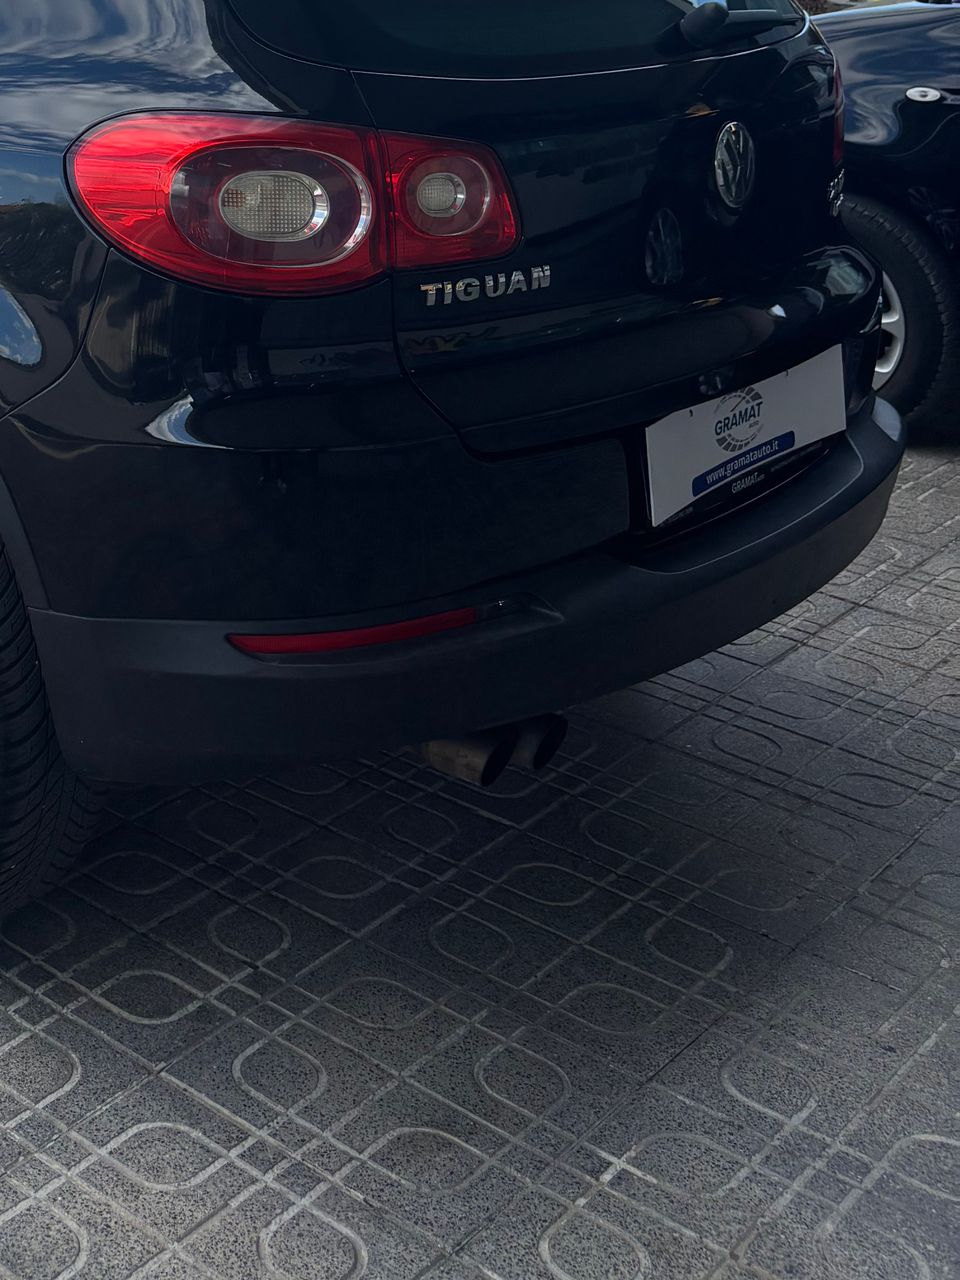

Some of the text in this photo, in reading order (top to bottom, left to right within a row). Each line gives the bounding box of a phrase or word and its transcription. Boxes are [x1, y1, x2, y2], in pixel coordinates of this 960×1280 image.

[420, 265, 551, 306] TIGUAN
[714, 401, 764, 436] GRAMAT
[705, 440, 779, 484] www.gramatauto.it
[731, 472, 759, 494] GRAMAT
